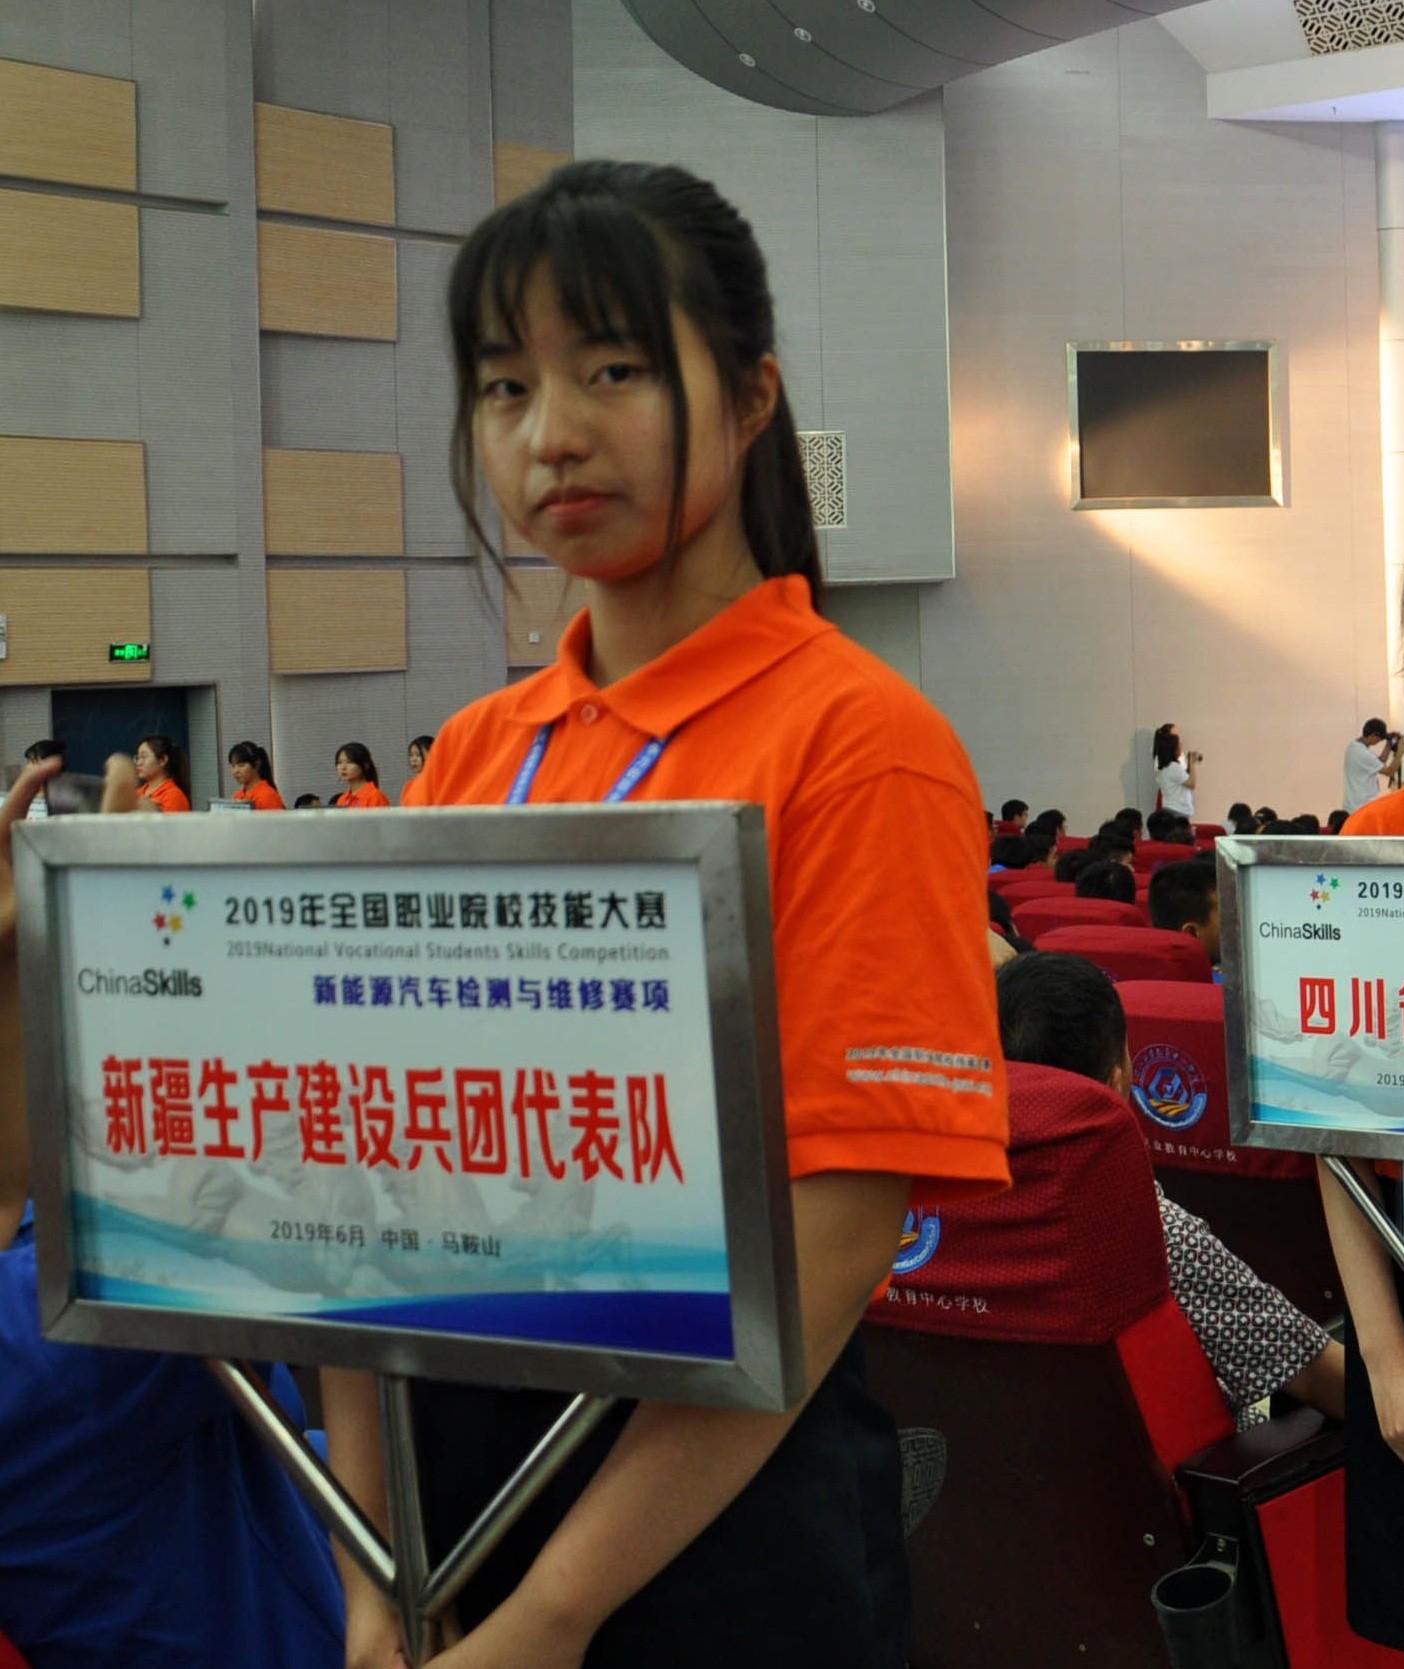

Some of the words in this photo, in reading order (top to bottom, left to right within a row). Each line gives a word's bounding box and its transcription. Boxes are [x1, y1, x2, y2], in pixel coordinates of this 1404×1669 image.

[225, 890, 669, 930] 2019年全国职业院校技能大赛
[1259, 922, 1341, 941] ChinaSkills
[334, 942, 420, 959] Vocational
[425, 942, 502, 961] Students
[506, 942, 552, 962] Skills
[557, 943, 670, 964] Competition
[78, 969, 204, 998] ChinaSkills
[313, 975, 671, 1012] 新能源汽车检测与维修赛项
[102, 1054, 685, 1186] 新疆生产建设兵团代表队
[270, 1221, 366, 1248] 2019年6月
